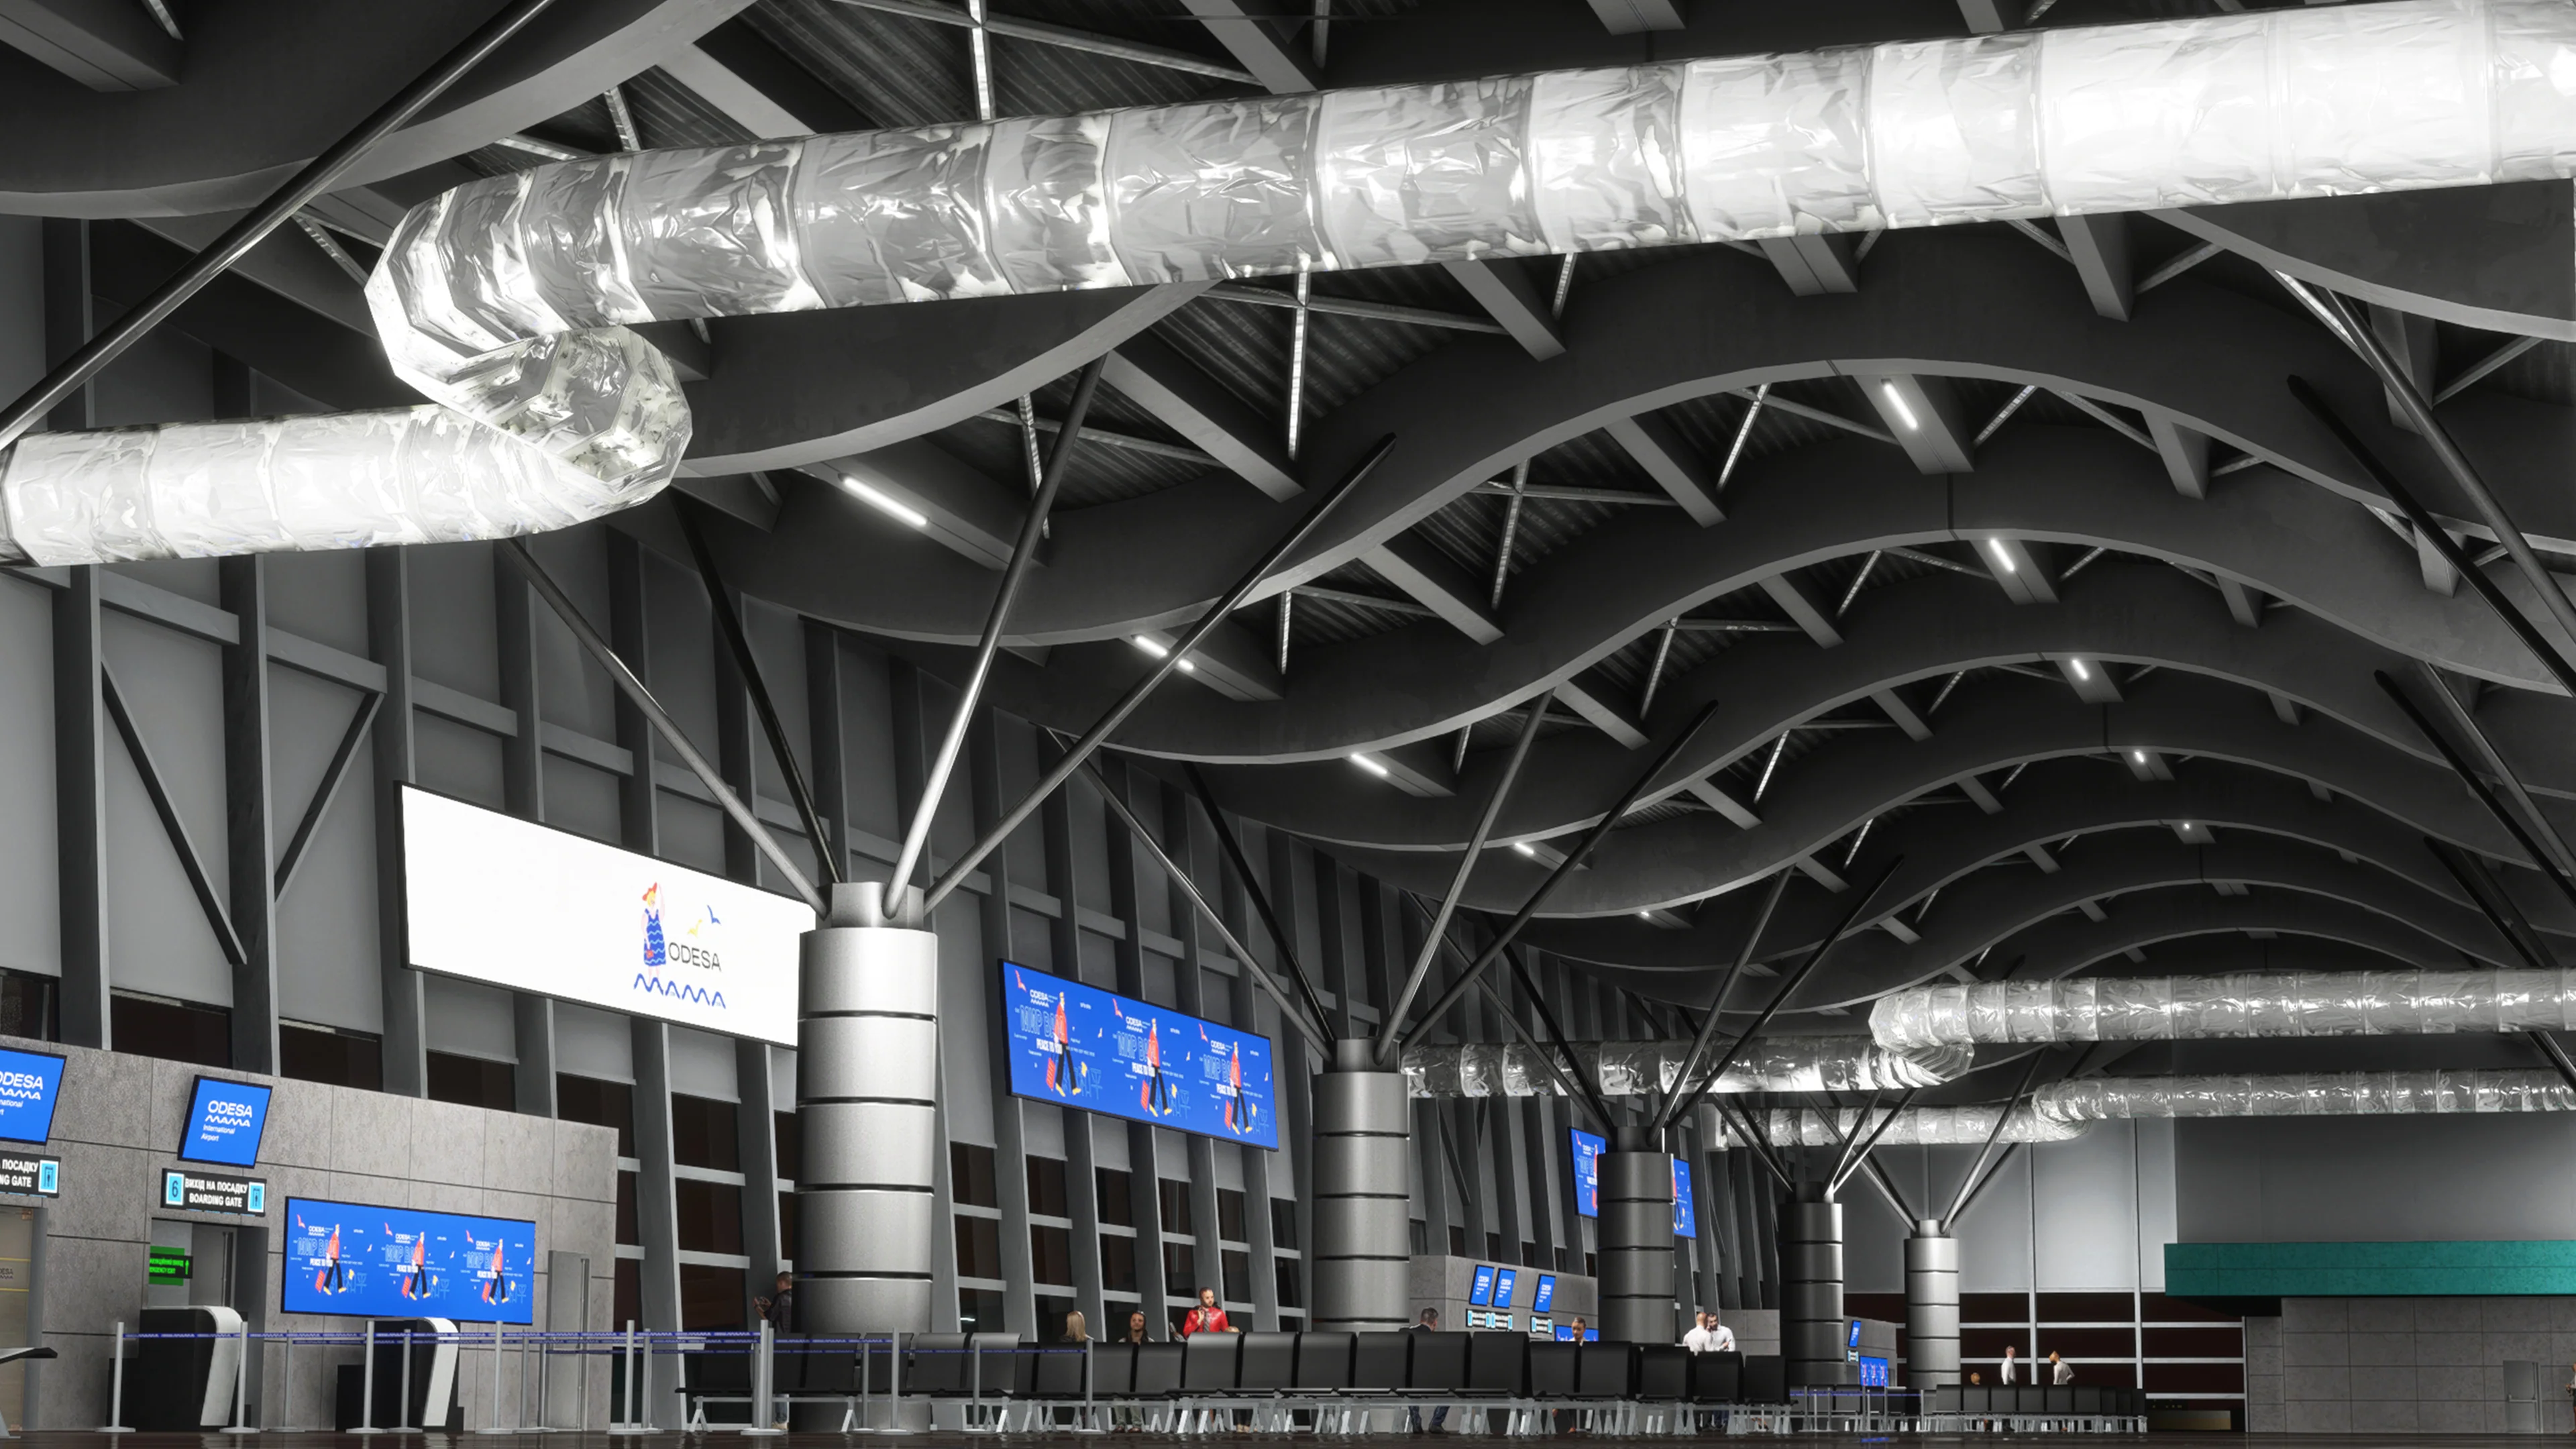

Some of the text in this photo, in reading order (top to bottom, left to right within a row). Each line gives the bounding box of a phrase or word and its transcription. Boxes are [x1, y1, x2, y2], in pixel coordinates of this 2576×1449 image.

[668, 942, 722, 972] ODESA
[208, 1100, 252, 1118] ODESA
[205, 1114, 251, 1127] MAMA
[203, 1124, 235, 1134] International
[201, 1133, 219, 1142] Airport
[2, 1159, 38, 1173] ПОСАДКУ
[11, 1175, 32, 1187] GATE
[184, 1178, 248, 1195] ВИХІД НА ПОСАДКУ
[172, 1180, 178, 1197] 6
[189, 1193, 242, 1208] BOARDING GATE
